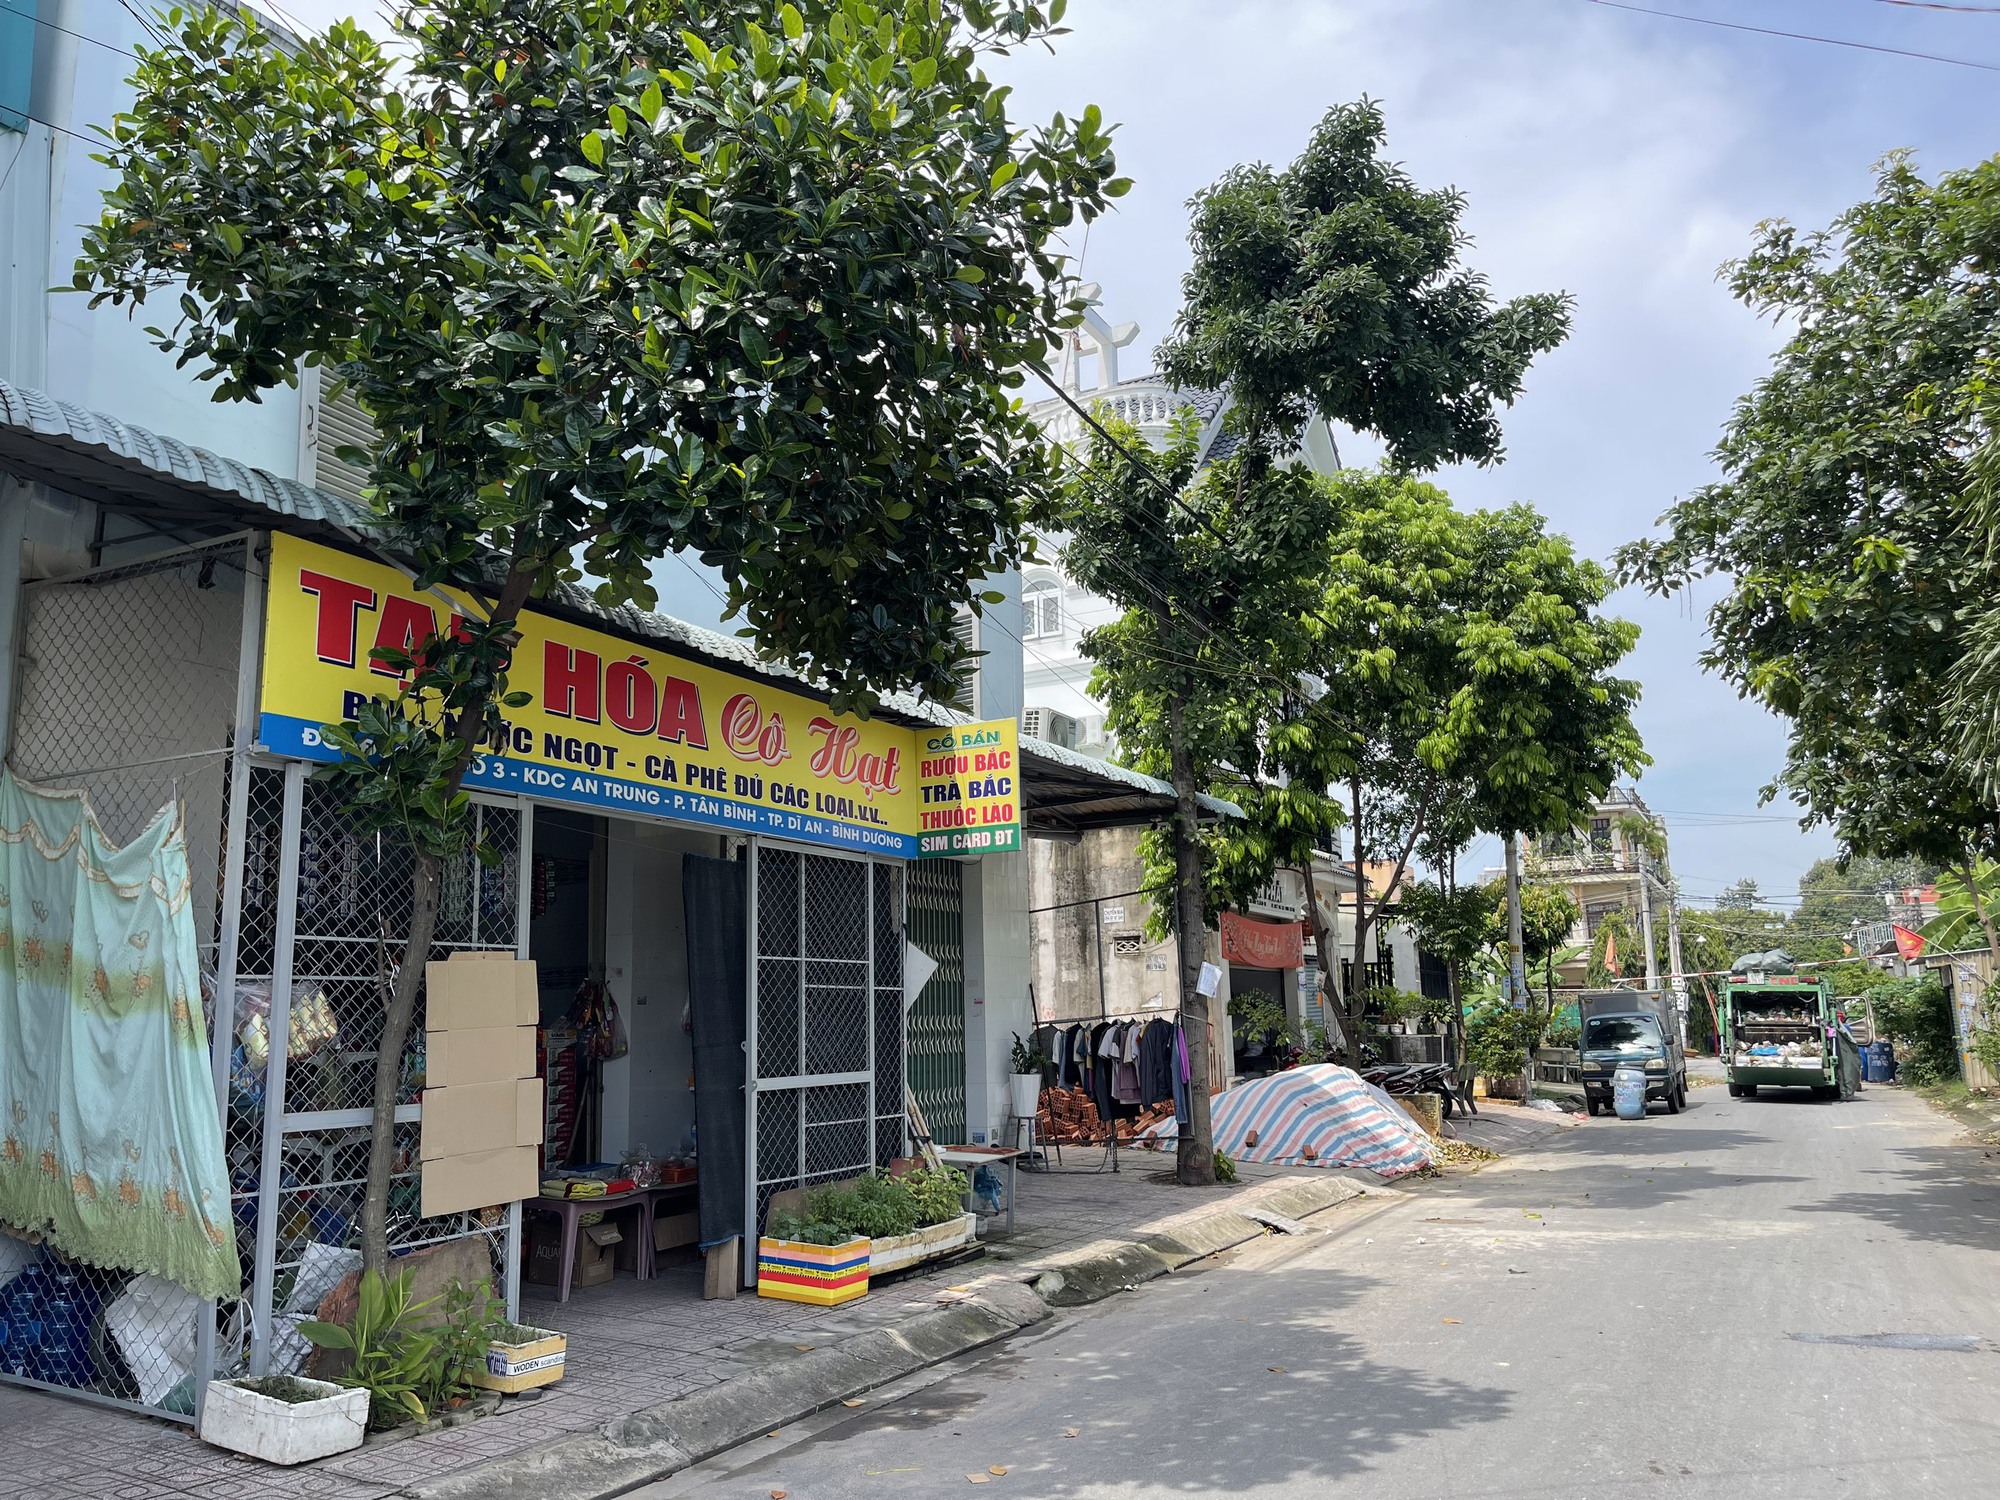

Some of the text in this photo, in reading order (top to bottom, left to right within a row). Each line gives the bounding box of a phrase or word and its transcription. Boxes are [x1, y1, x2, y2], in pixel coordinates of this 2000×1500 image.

[543, 640, 709, 750] HÓA
[721, 693, 792, 767] Cô
[807, 717, 901, 801] Hạt
[926, 729, 1000, 750] CÓ BÁN
[544, 733, 619, 771] NGỌT
[645, 755, 678, 784] CÀ
[686, 766, 727, 793] PHÊ
[734, 774, 763, 799] ĐỦ
[771, 783, 809, 809] CÁC
[921, 747, 1011, 779] RƯỢU BẮC
[921, 774, 1011, 804] TRÀ BẮC
[492, 762, 505, 779] 3
[523, 767, 566, 788] KDC
[571, 776, 598, 795] AN
[603, 781, 660, 806] TRUNG
[674, 795, 686, 811] P.
[691, 796, 719, 816] TÂN
[724, 801, 757, 823] BÌNH
[768, 813, 784, 828] TP.
[805, 822, 822, 835] AN
[832, 823, 859, 842] BÌNH
[862, 830, 903, 849] DƯƠNG
[920, 802, 1013, 830] THUỐC LÀO
[921, 829, 1014, 852] SIM CARD ĐT
[536, 1243, 561, 1259] AQUA
[513, 1360, 539, 1373] WODEN
